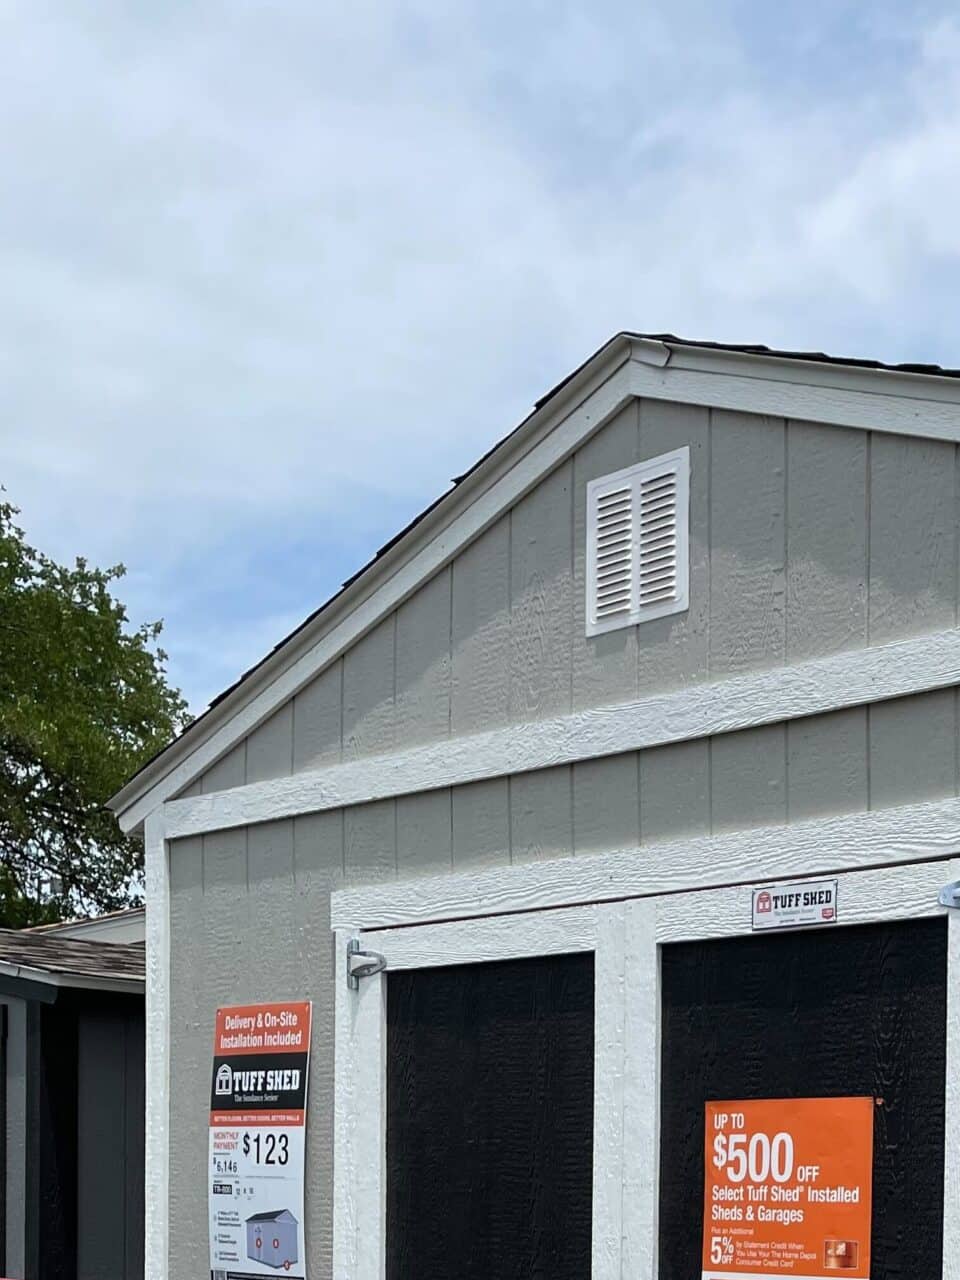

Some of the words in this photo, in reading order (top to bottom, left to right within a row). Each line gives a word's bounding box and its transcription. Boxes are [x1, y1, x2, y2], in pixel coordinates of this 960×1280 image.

[773, 892, 801, 909] TUFF
[803, 890, 832, 906] SHED
[225, 1015, 255, 1031] Delivery
[257, 1014, 262, 1027] &
[265, 1013, 298, 1026] On-Site
[221, 1033, 262, 1049] Installation
[264, 1031, 302, 1046] Included
[233, 1071, 266, 1091] TUFF
[267, 1069, 300, 1090] SHED
[714, 1114, 729, 1128] UP
[731, 1113, 744, 1128] TO
[213, 1132, 239, 1140] MONTHLY
[213, 1142, 239, 1150] PAYMENT
[243, 1132, 289, 1165] $123
[713, 1131, 794, 1182] $500
[797, 1166, 820, 1182] OFF
[712, 1185, 744, 1201] Select
[747, 1186, 768, 1201] Tuff
[808, 1187, 860, 1203] Installed
[712, 1204, 743, 1221] Sheds
[745, 1206, 755, 1221] &
[757, 1206, 804, 1225] Garages
[722, 1255, 734, 1264] OFF
